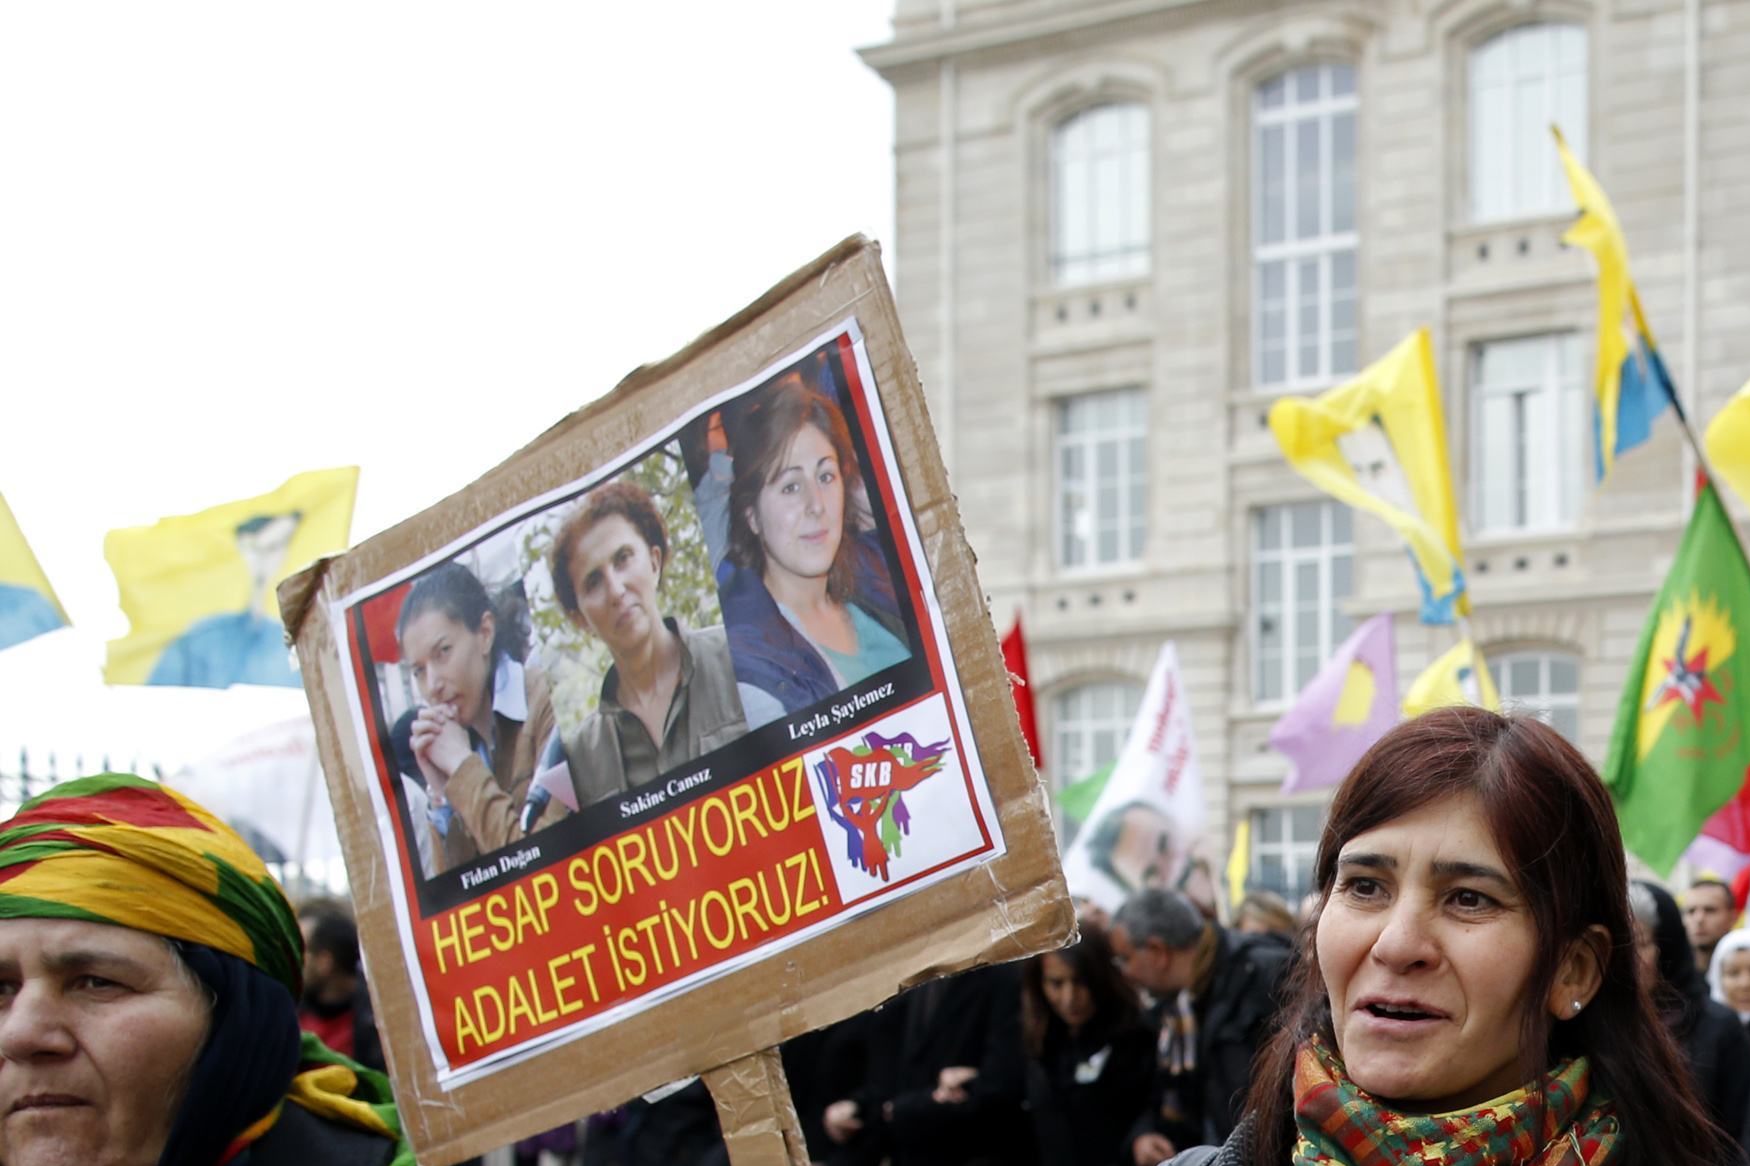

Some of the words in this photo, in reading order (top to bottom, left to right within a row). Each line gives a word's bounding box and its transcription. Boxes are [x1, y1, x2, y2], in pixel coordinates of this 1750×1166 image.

[788, 714, 830, 740] Leyla
[831, 681, 895, 725] Şaylemez
[620, 790, 666, 818] Sakine
[667, 768, 712, 797] Cansız
[851, 761, 892, 789] SKB
[431, 873, 560, 974] HESAP
[567, 757, 816, 917] SORUYORUZ
[460, 864, 498, 890] Fidan
[500, 845, 541, 873] Doğan
[453, 944, 601, 1055] ADALET
[604, 848, 830, 992] İSTİYORUZ!
